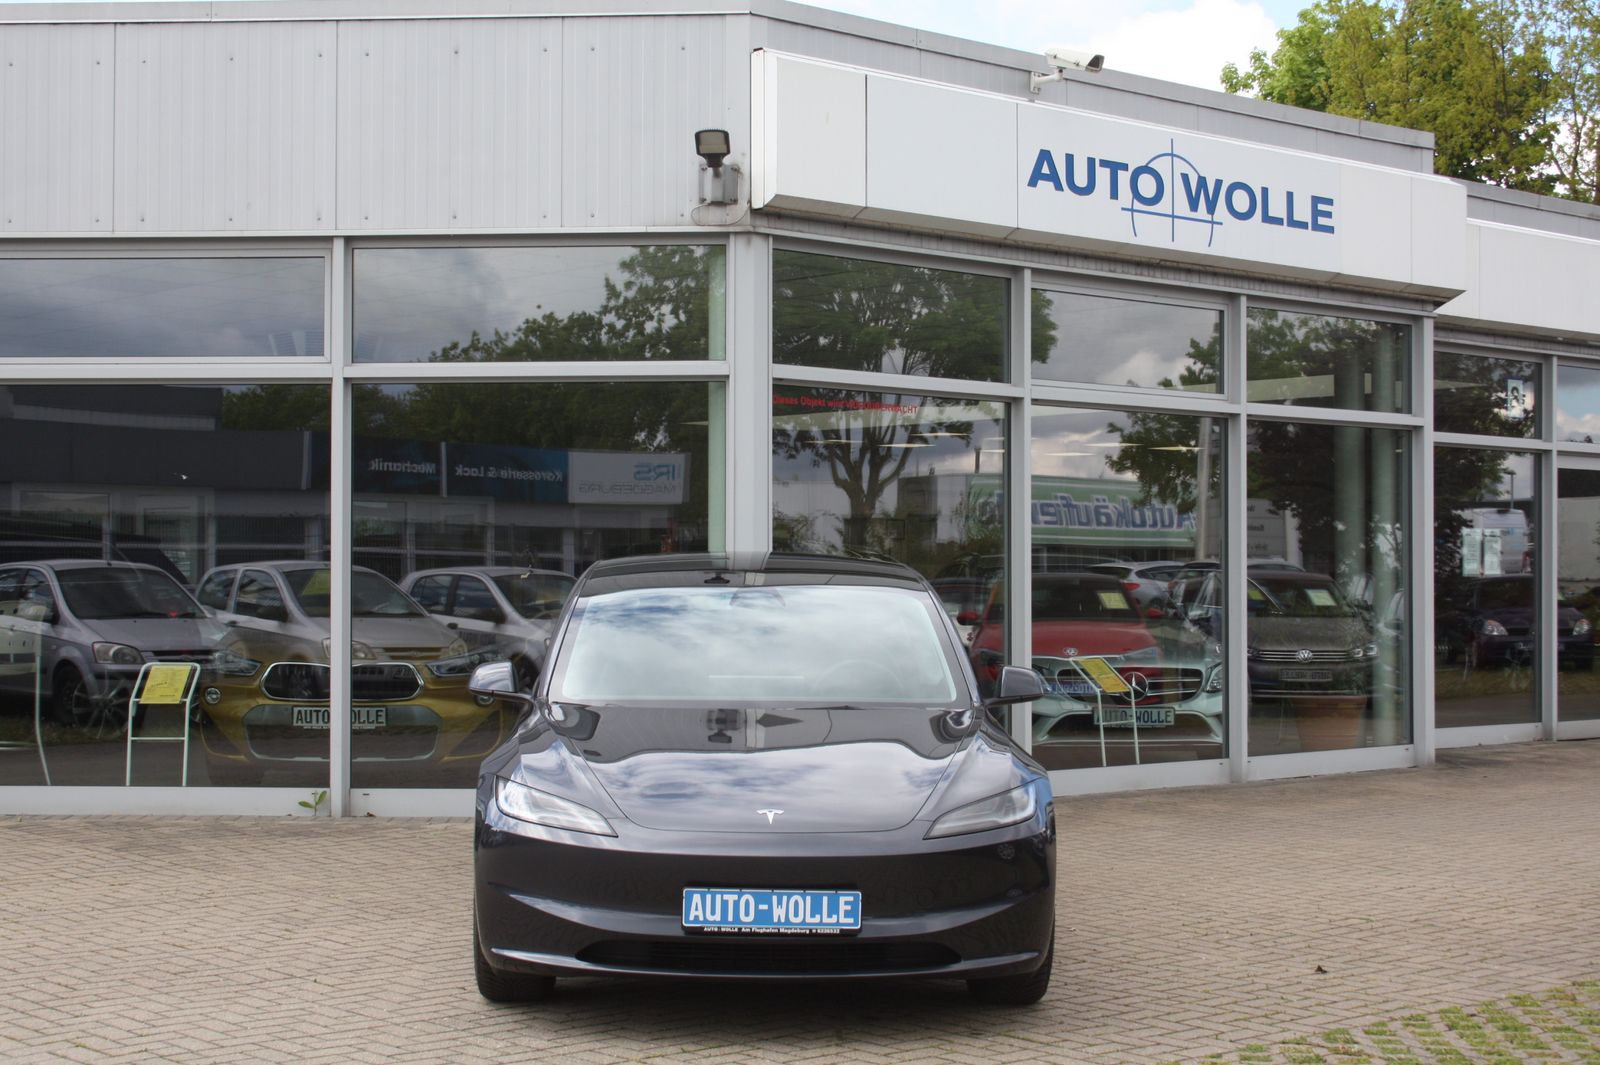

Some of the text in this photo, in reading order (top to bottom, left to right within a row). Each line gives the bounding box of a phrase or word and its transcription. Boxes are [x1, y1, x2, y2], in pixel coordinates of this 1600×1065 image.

[1027, 148, 1335, 234] AUTO WOLLE
[689, 893, 854, 924] AUTO-WOLLE
